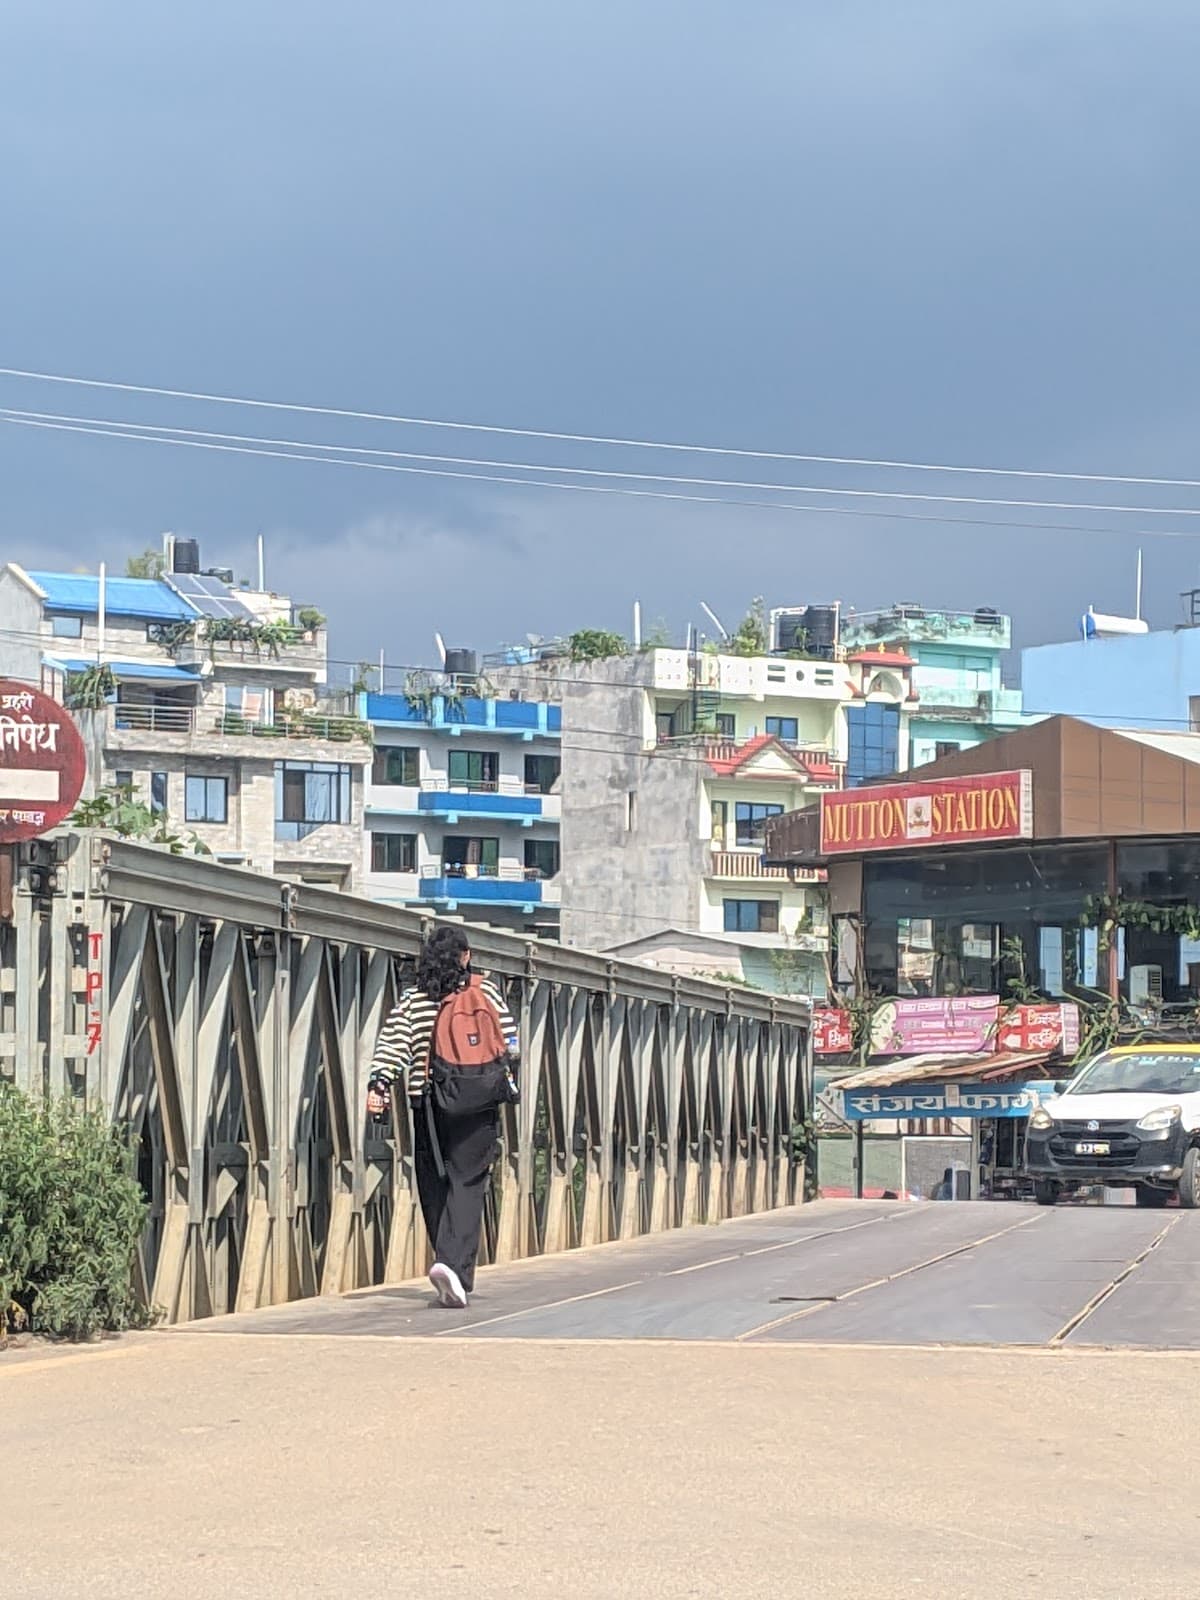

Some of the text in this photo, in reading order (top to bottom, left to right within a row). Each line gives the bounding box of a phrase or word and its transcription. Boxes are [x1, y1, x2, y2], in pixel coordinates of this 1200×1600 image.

[824, 798, 907, 843] MUTTON
[932, 785, 1018, 835] STATION
[851, 1094, 945, 1113] संजय
